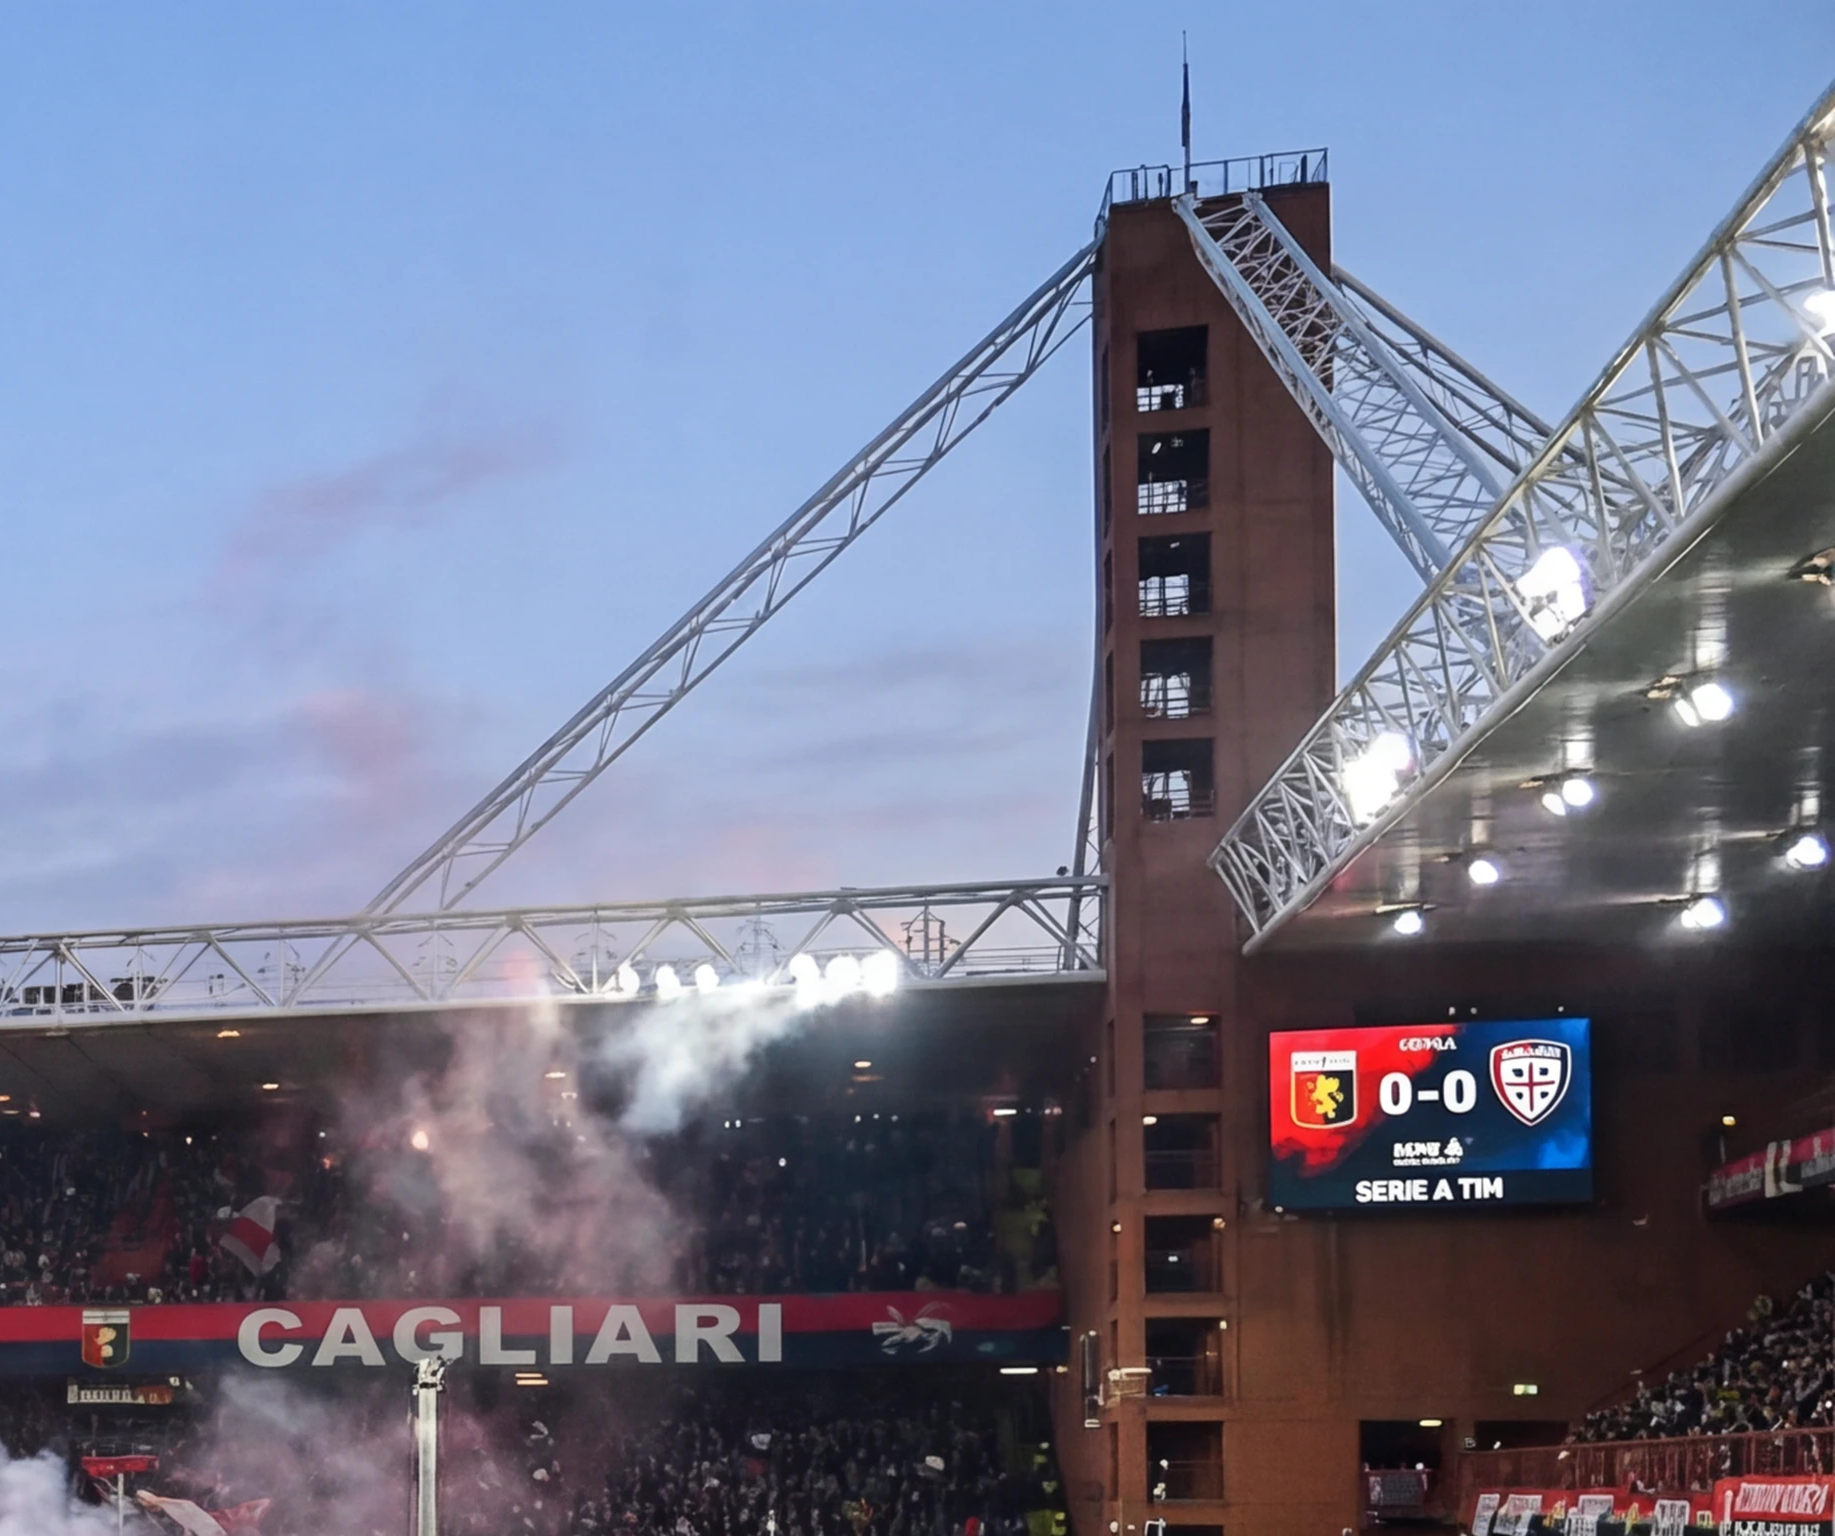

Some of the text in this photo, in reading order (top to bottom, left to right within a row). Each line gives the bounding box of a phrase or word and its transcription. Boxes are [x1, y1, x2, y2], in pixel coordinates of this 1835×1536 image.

[1379, 1069, 1477, 1115] 0-0
[1356, 1177, 1504, 1203] SERIE A TIM
[237, 1303, 784, 1367] CAGLIARI
